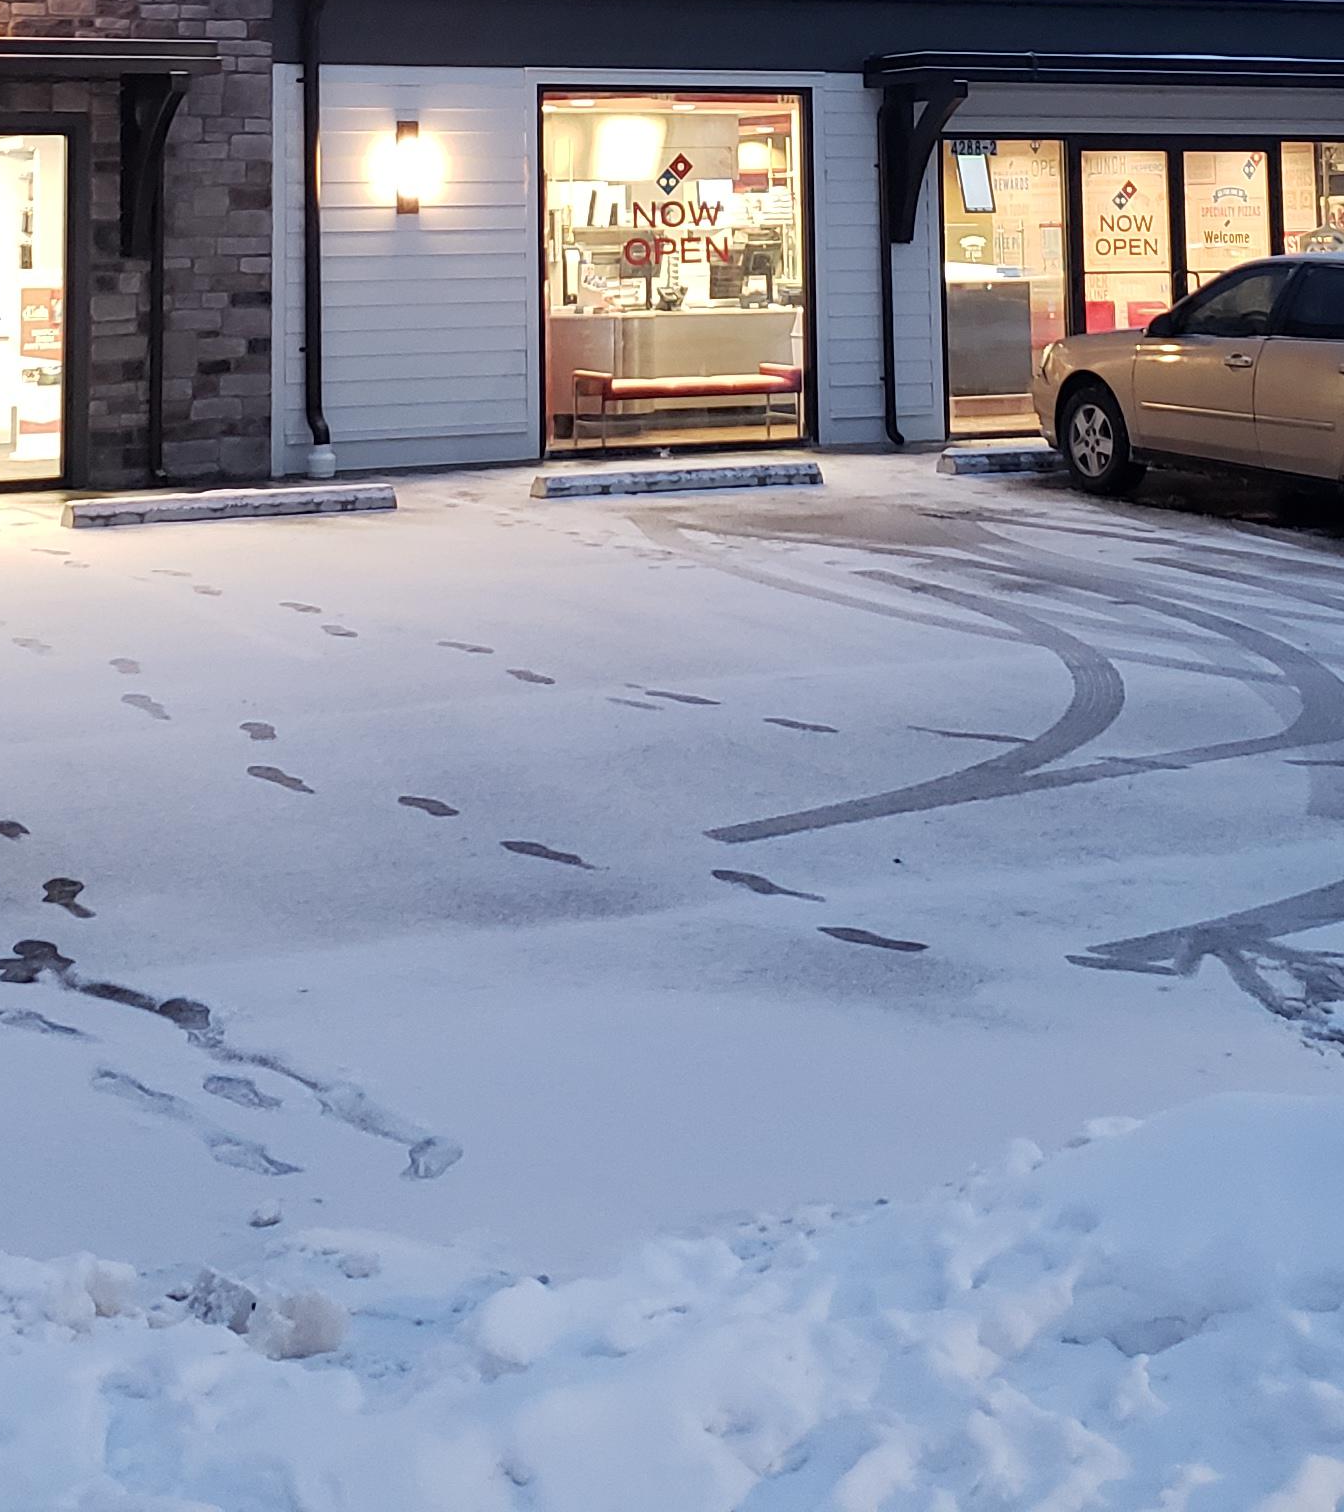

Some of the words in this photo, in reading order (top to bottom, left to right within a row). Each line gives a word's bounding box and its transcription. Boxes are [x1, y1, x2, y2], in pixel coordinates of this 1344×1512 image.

[950, 140, 998, 156] 4288-2
[632, 200, 721, 229] NOW
[1099, 214, 1154, 233] NOW
[1203, 230, 1251, 244] Welcome
[625, 236, 730, 266] OPEN
[1095, 238, 1159, 256] OPEN
